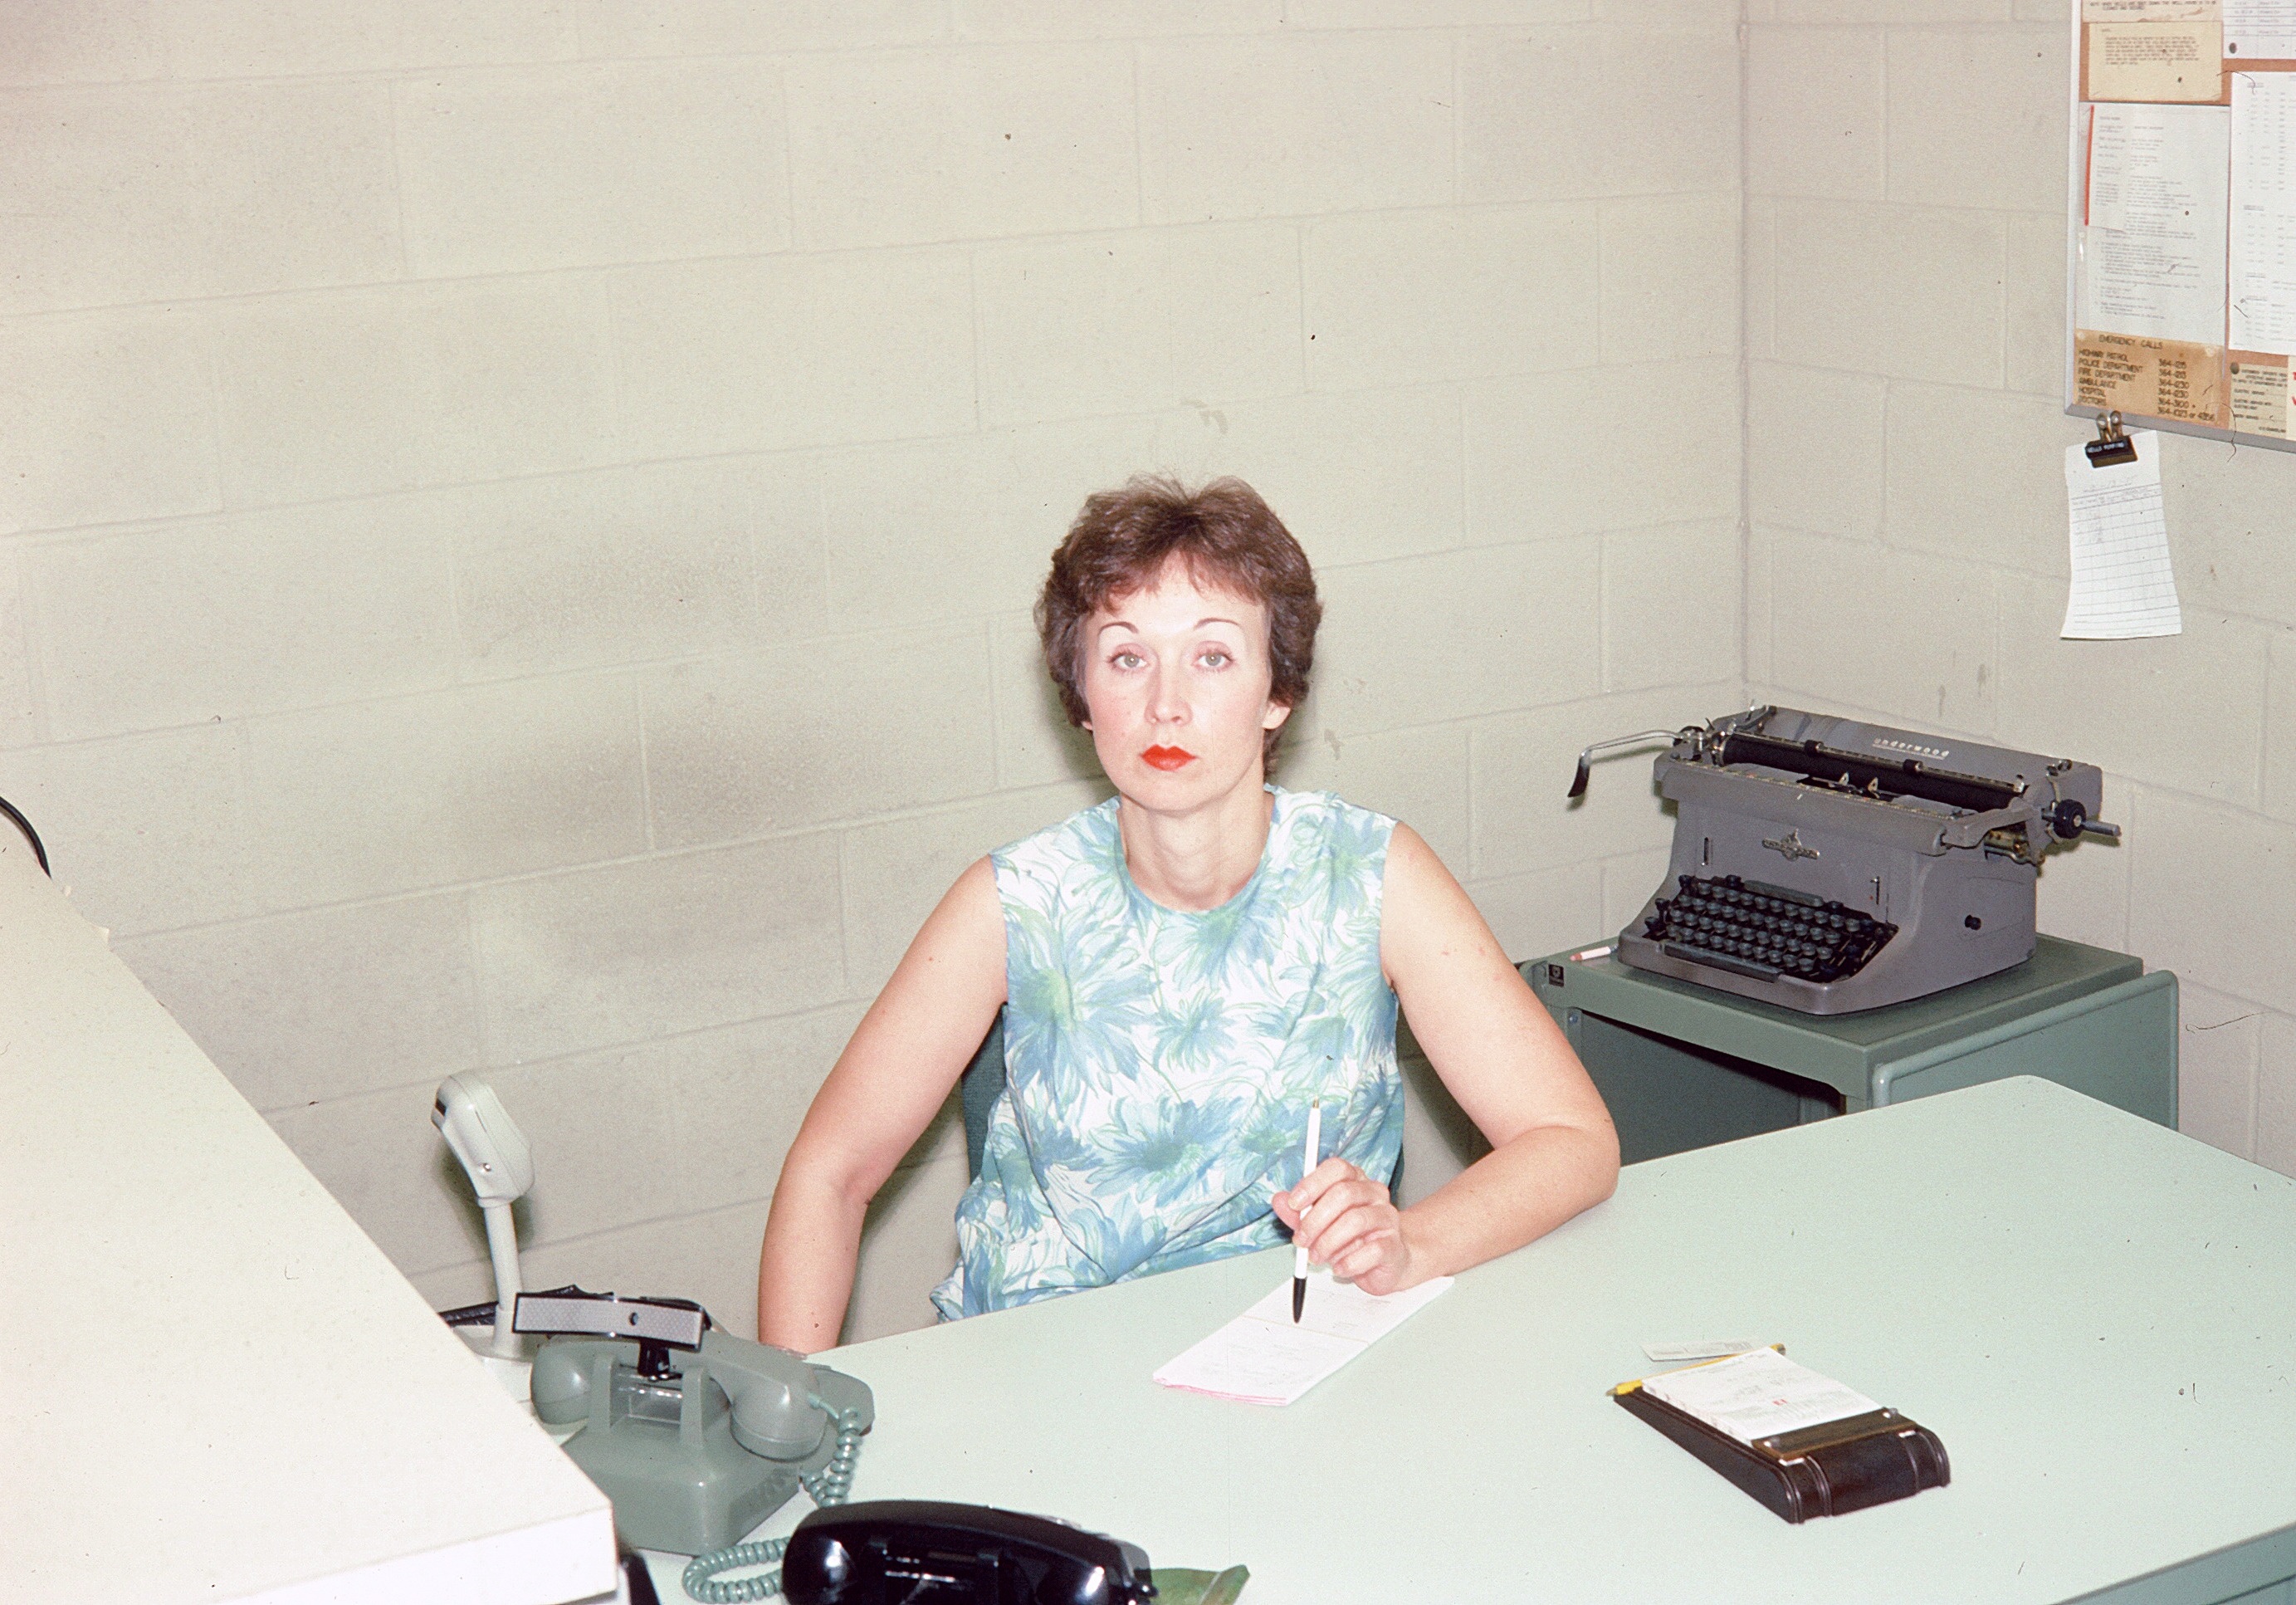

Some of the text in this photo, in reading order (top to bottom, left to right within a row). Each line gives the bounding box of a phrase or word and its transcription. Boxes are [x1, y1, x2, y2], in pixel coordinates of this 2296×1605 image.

[2098, 335, 2163, 350] EMERGENCY CALLS
[2106, 351, 2128, 362] PATROL
[2079, 358, 2099, 368] POLICE
[2103, 360, 2143, 373] DEPARTMENT
[2079, 367, 2091, 376] FIRE
[2095, 369, 2136, 382] DEPARTMENT
[2079, 377, 2117, 389] AMBULANCE
[2079, 387, 2106, 398] HOSPITAL
[2078, 395, 2107, 406] DOCTORS
[1873, 737, 1950, 757] underwood
